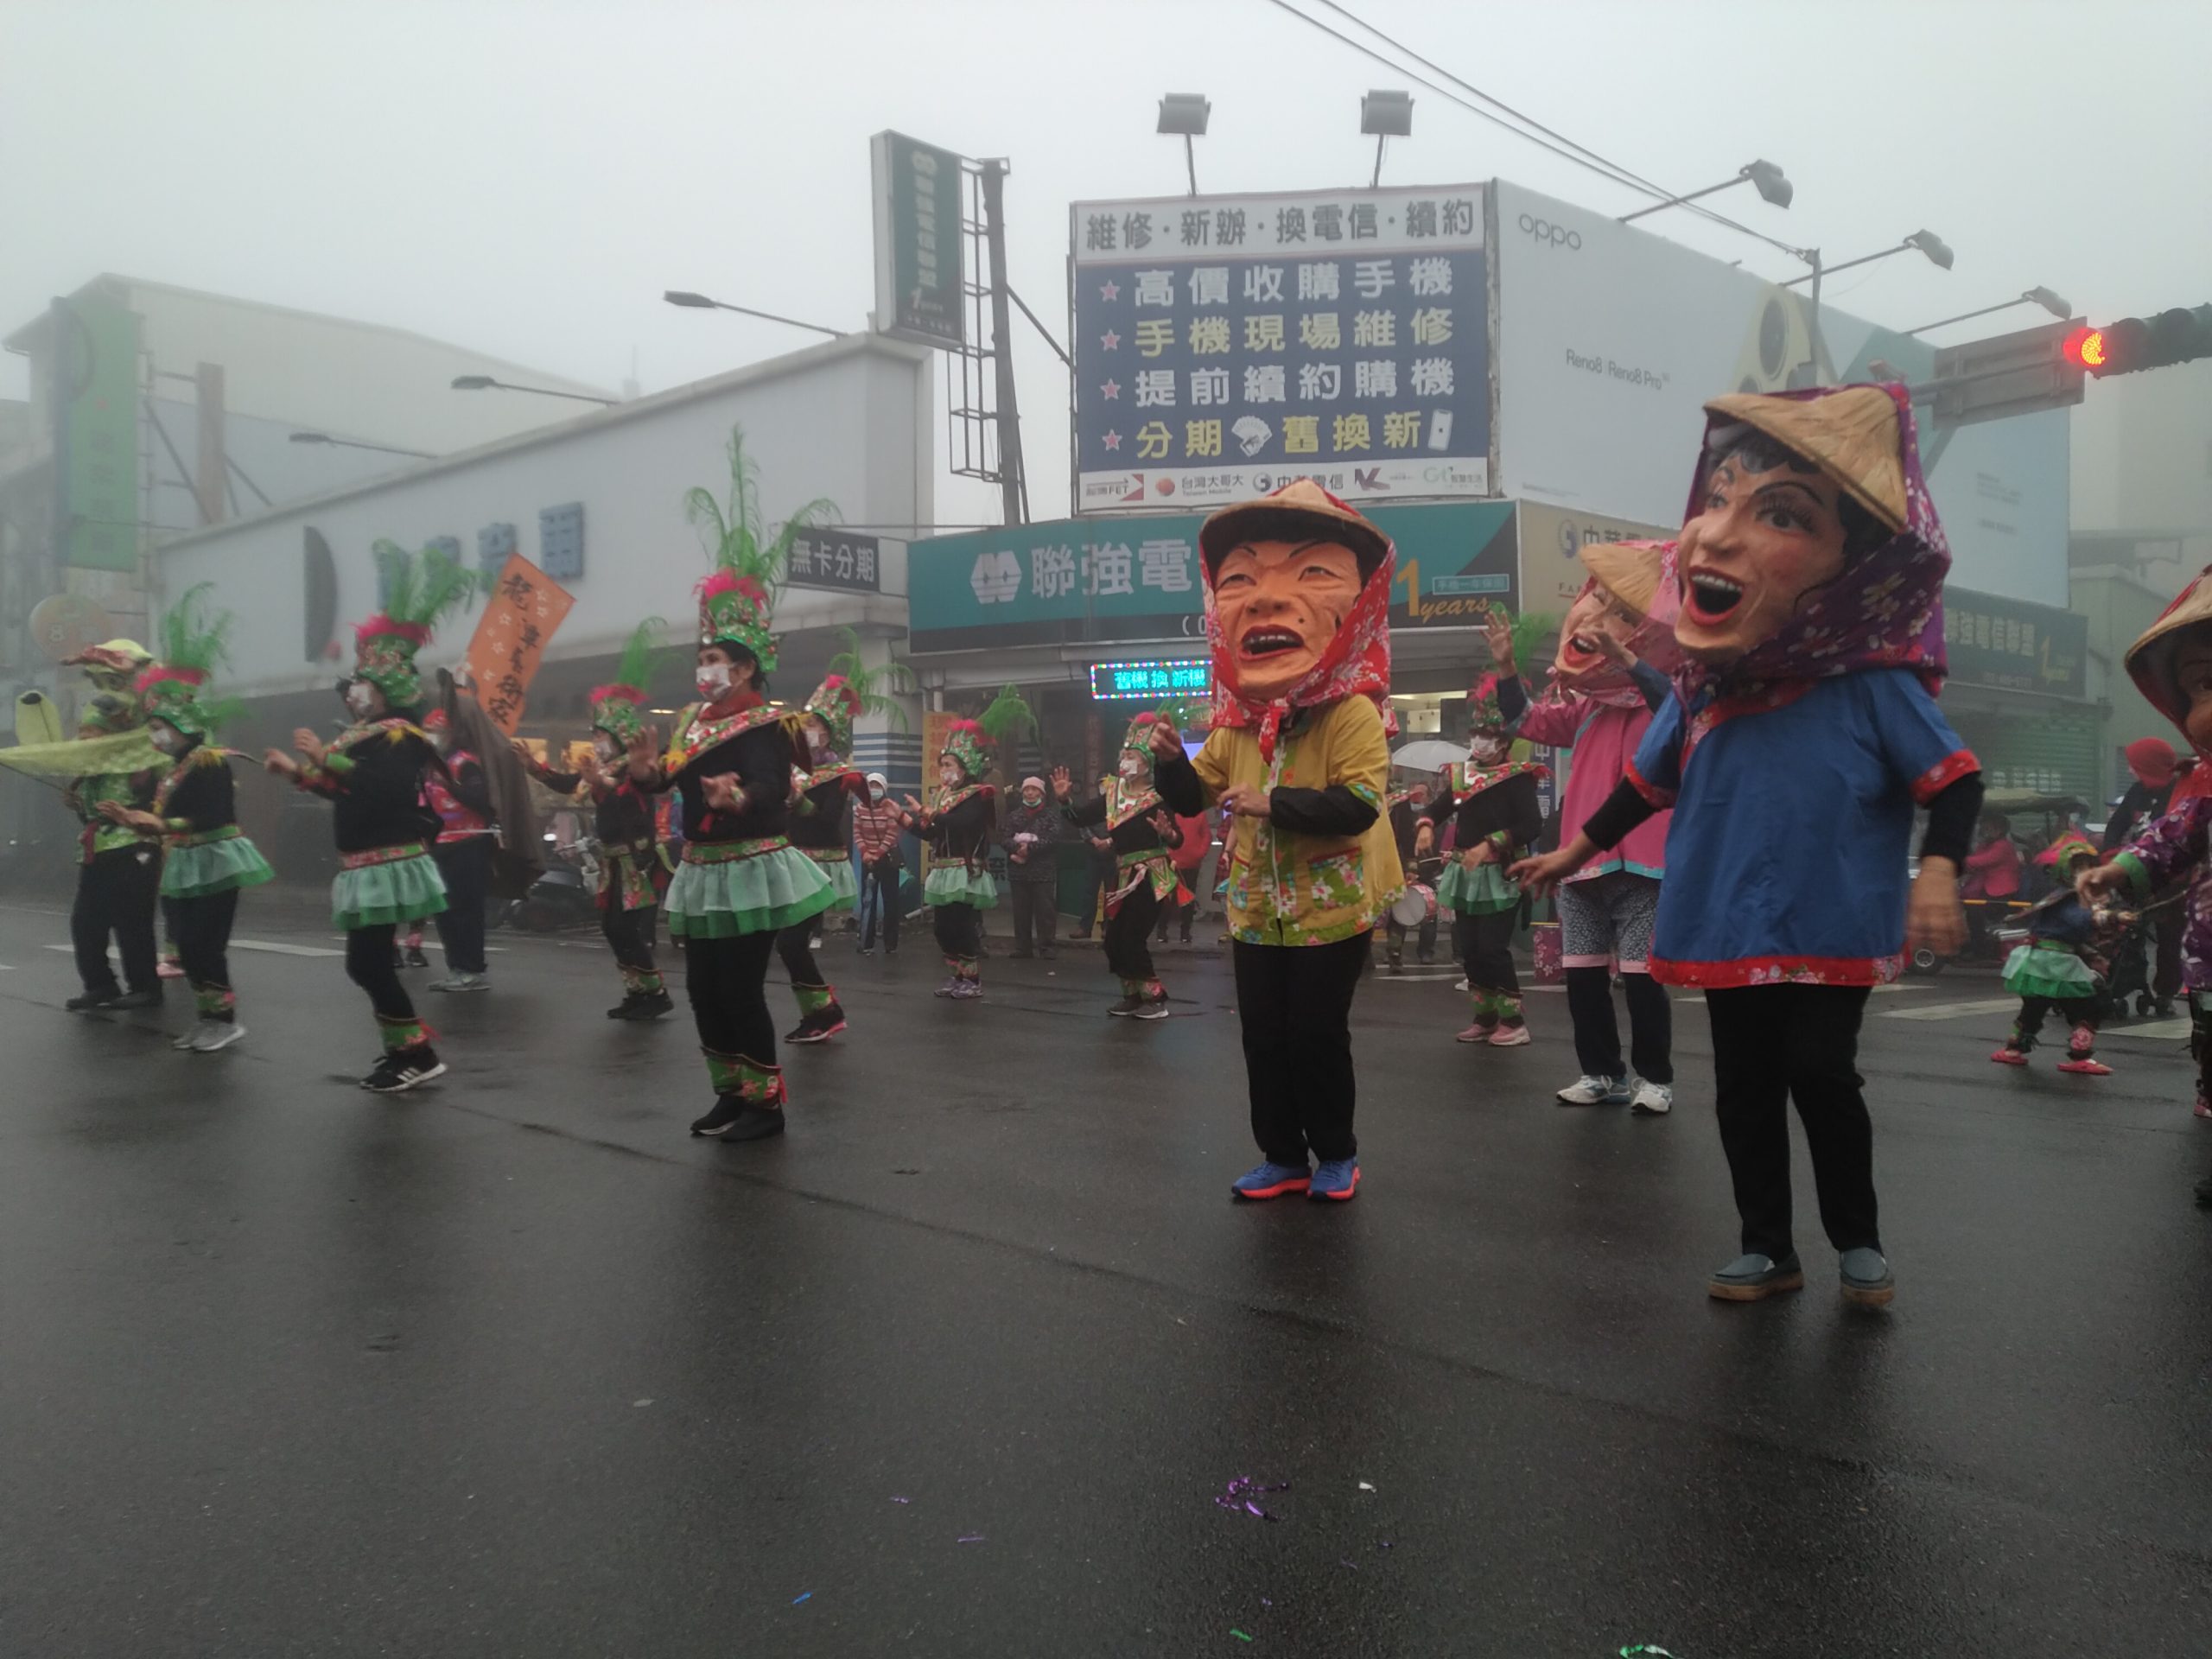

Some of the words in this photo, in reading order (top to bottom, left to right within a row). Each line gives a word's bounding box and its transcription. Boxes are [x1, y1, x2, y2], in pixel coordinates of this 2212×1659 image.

[1518, 213, 1582, 251] oppo
[1135, 257, 1452, 307] 高價收購手機
[1135, 307, 1454, 357] 手機現場維修
[1135, 357, 1455, 407] 提前續約購機
[1566, 348, 1603, 374] Reno8
[1608, 359, 1643, 385] Reno8
[1643, 370, 1662, 390] Pro
[1182, 474, 1244, 489] 台灣大哥大
[1277, 474, 1344, 490] 中電信
[791, 537, 875, 583] 無卡分期
[1032, 537, 1192, 600] 聯強電
[1396, 558, 1421, 617] 1
[1420, 596, 1490, 625] years
